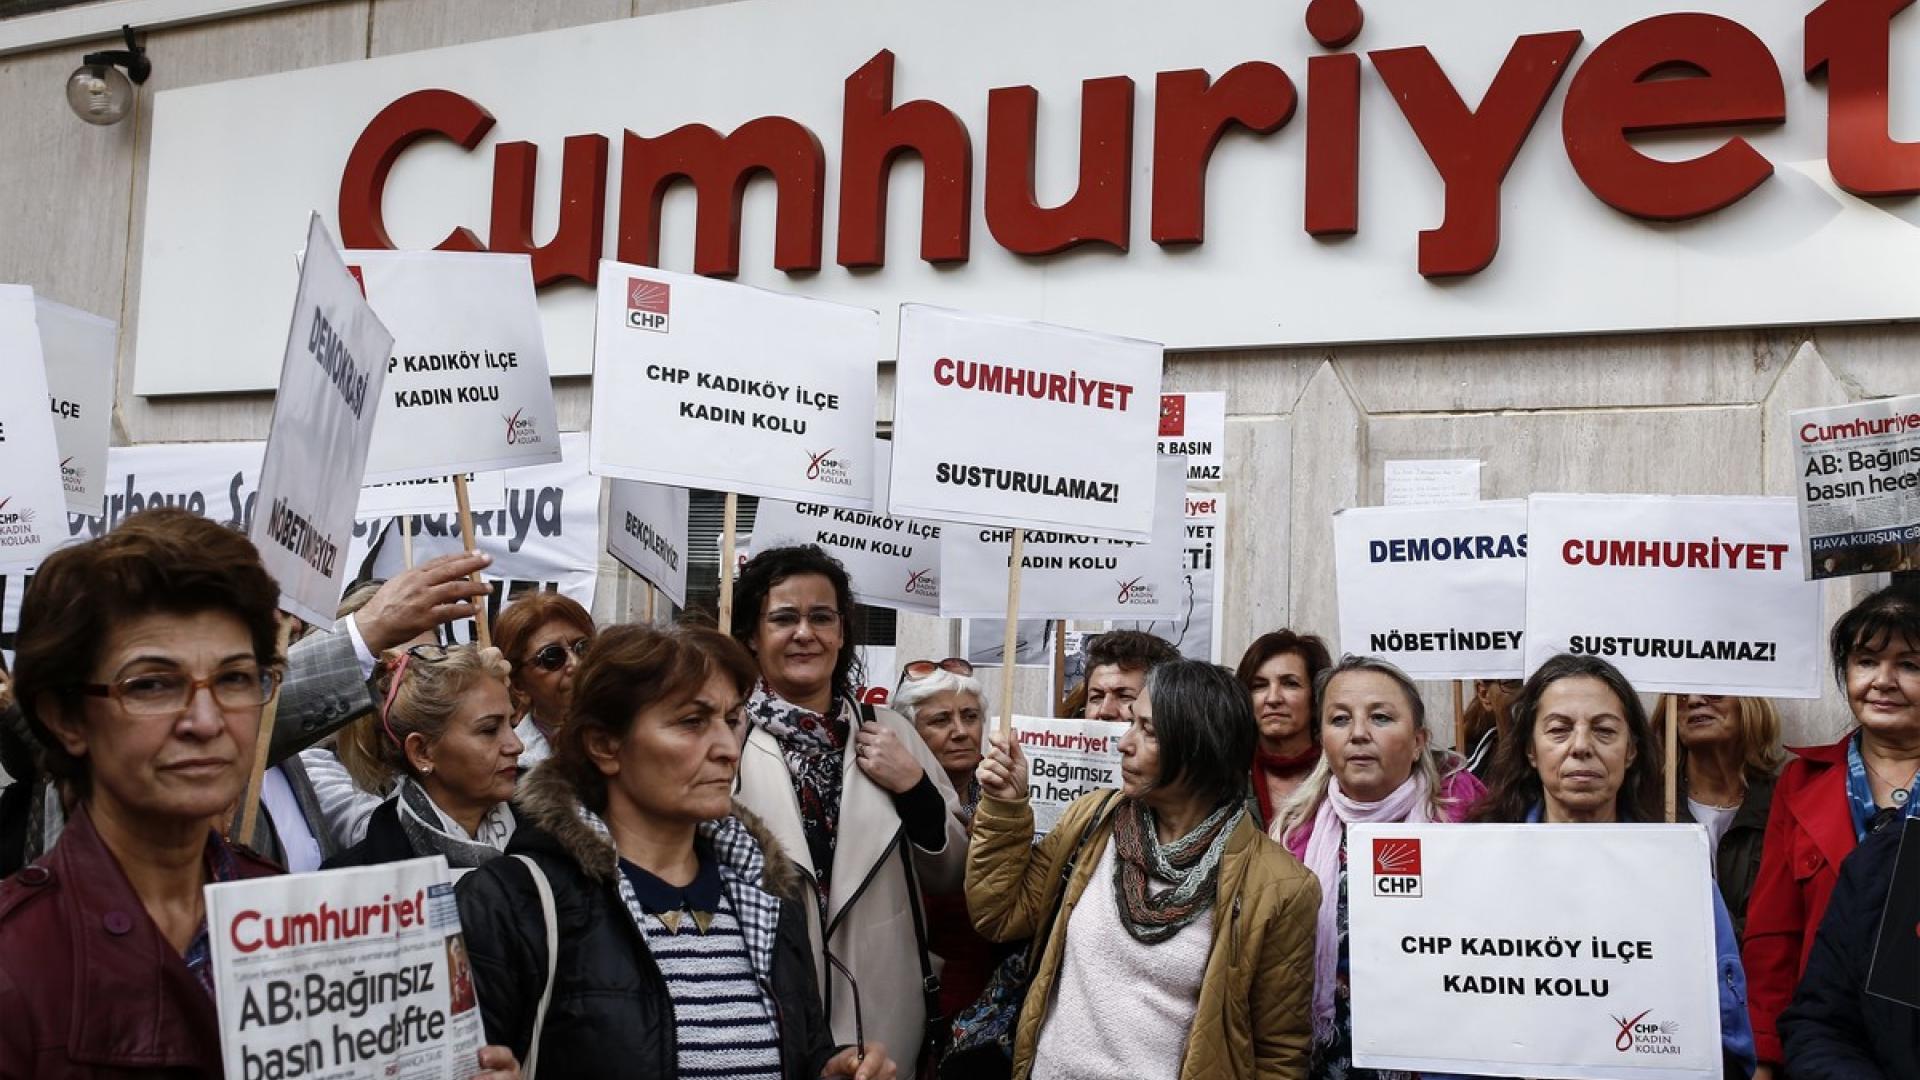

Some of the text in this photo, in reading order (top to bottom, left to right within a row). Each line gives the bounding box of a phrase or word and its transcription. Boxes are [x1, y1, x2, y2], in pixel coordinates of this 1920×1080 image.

[631, 312, 665, 329] CHP
[403, 350, 480, 373] KADIKÖY
[484, 349, 518, 372] İLÇE
[395, 385, 499, 408] KADIN KOLU
[646, 364, 839, 411] CHP KADIKÖY İLÇE
[934, 358, 1134, 411] CUMHURİYET
[49, 395, 80, 419] LÇE
[680, 401, 807, 435] KADIN KOLU
[1169, 442, 1212, 455] BASIN
[821, 459, 838, 467] CHP
[1804, 455, 1843, 478] AB:
[936, 463, 1119, 503] SUSTURULAMAZ!
[1806, 479, 1864, 502] basın
[796, 502, 829, 517] CHP
[907, 519, 941, 539] İLÇE
[816, 531, 912, 558] KADIN KOLU
[1562, 537, 1789, 570] CUMHURİYET
[1814, 537, 1848, 550] HAVA
[1069, 557, 1117, 569] KOLU
[1370, 628, 1523, 652] NÖBETİNDEY
[1569, 635, 1777, 662] SUSTURULAMAZ!
[1032, 758, 1112, 783] Bağımsız
[1378, 878, 1417, 894] CHP
[230, 888, 424, 953] Cumhuriyet
[1401, 936, 1653, 964] CHP KADIKÖY İLÇE
[1443, 975, 1609, 998] KADIN KOLU
[239, 980, 302, 1032] AB:
[1634, 1024, 1658, 1034] CHP
[1634, 1034, 1672, 1044] KADIN
[1635, 1044, 1681, 1056] KOLLARI
